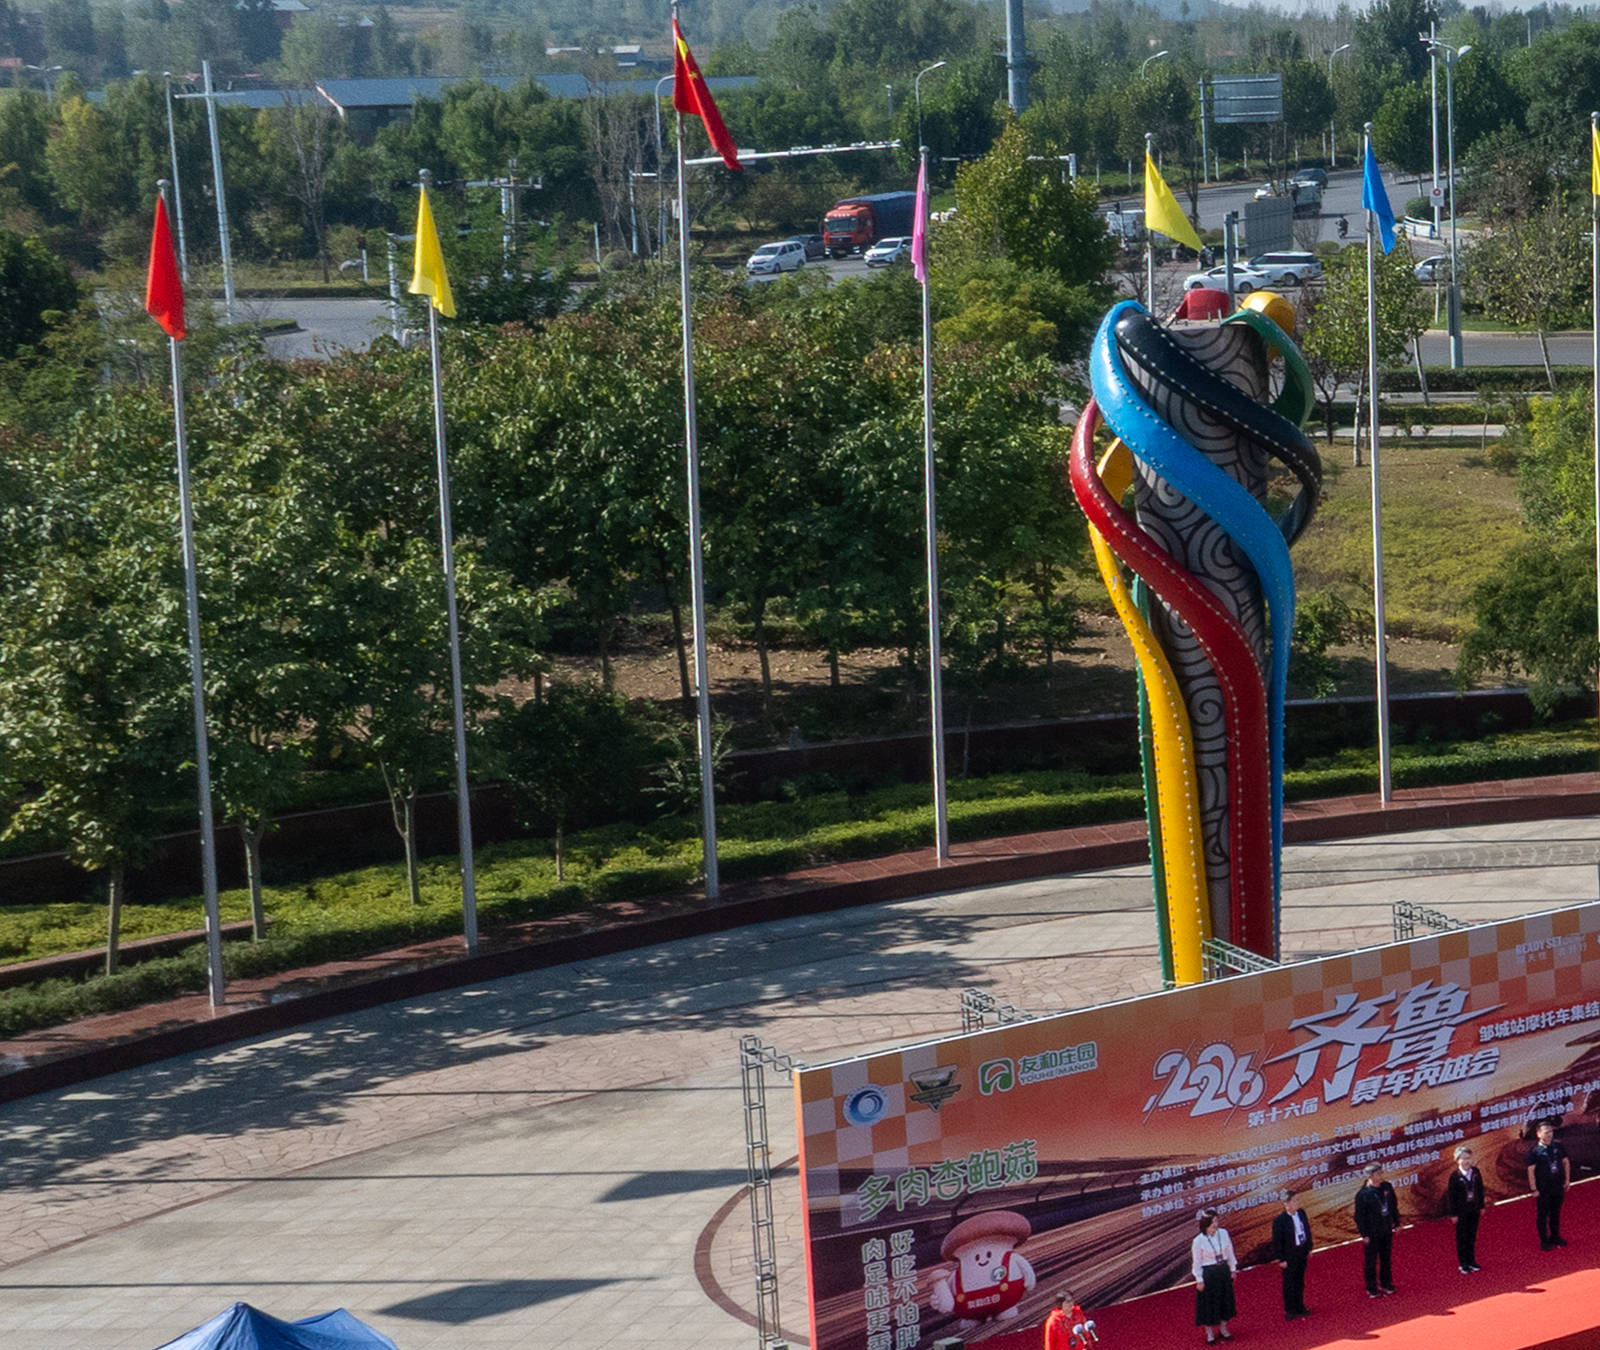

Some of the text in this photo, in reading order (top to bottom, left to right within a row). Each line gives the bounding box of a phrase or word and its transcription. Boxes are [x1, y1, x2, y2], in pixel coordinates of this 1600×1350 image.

[1018, 1041, 1098, 1075] 友和庄园
[1265, 980, 1507, 1104] 齐鲁
[1351, 1047, 1500, 1106] 赛车英雄会
[1247, 1097, 1319, 1128] 第十六届
[857, 1139, 1039, 1221] 多肉杏鲍菇
[889, 1228, 921, 1350] 好吃不怕胖
